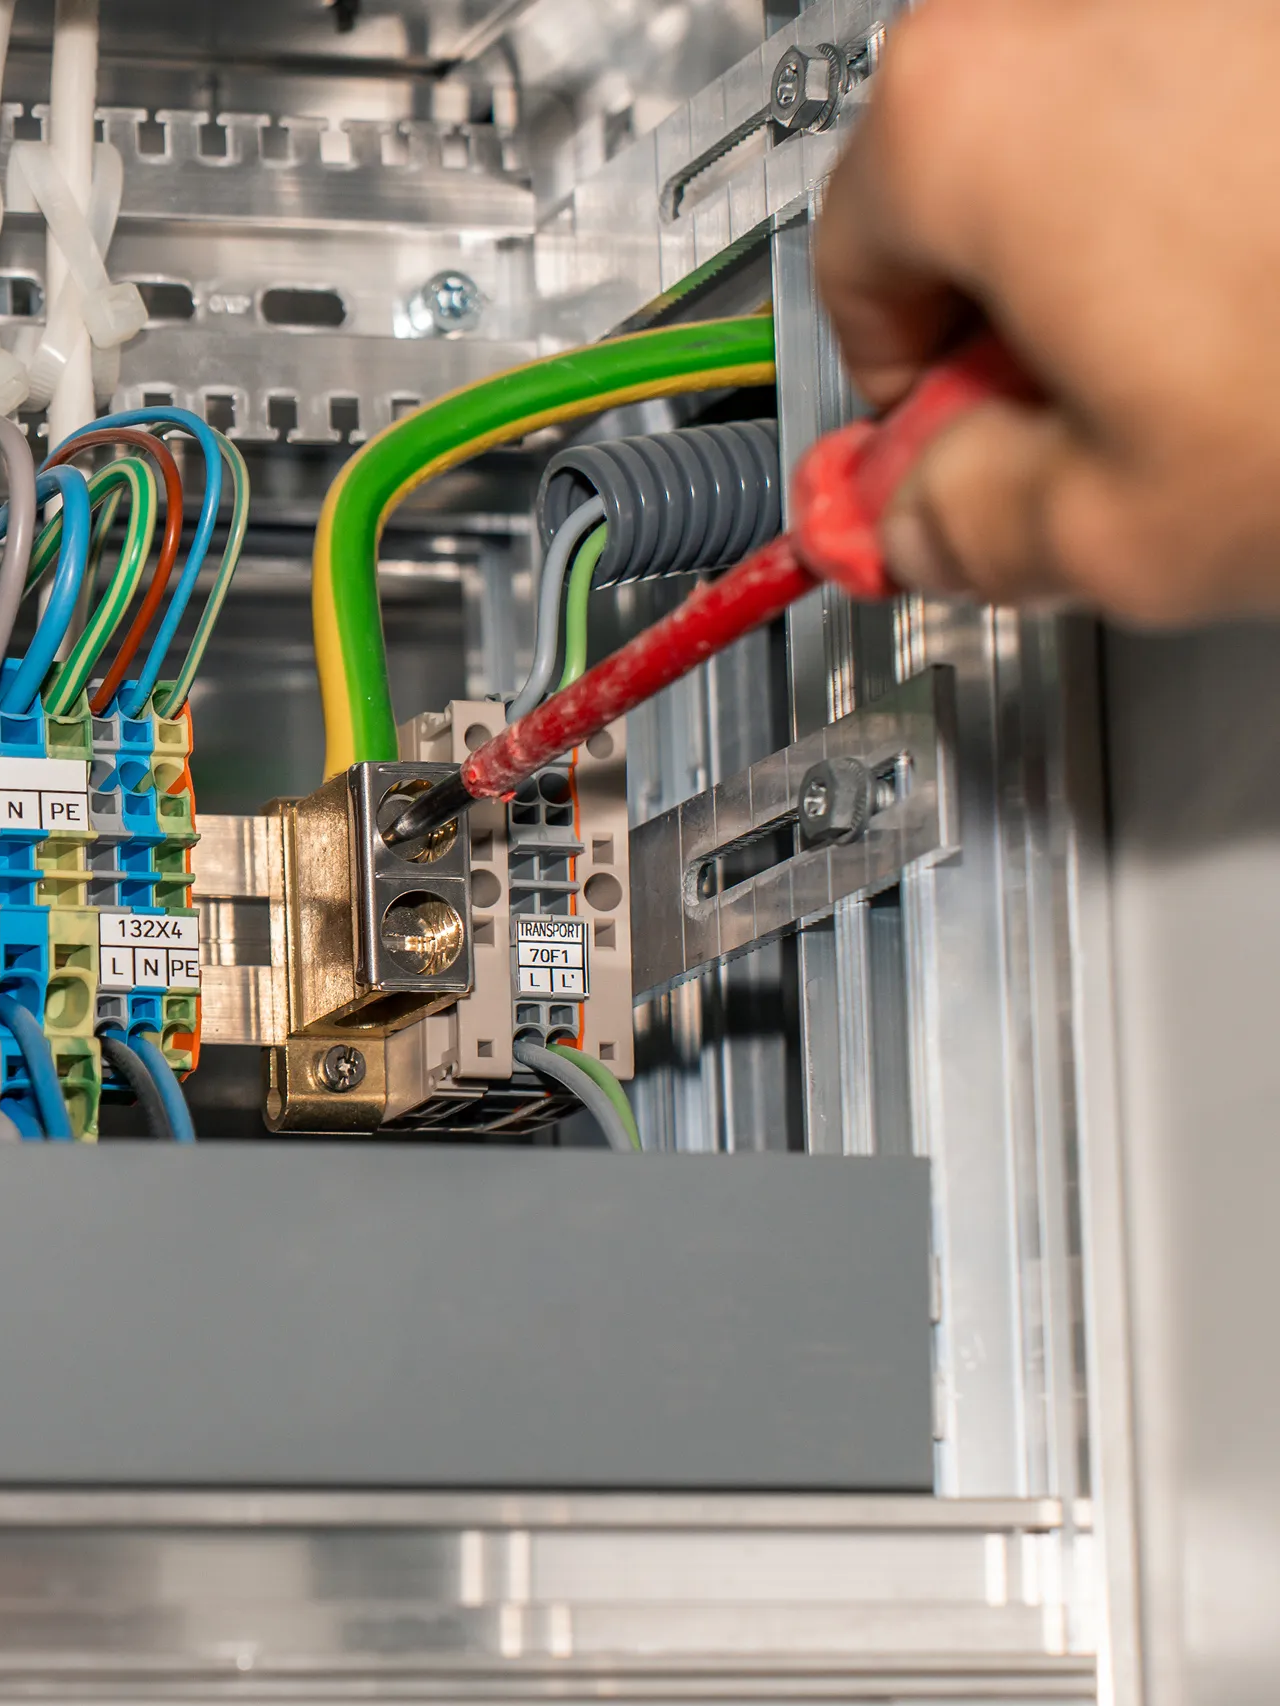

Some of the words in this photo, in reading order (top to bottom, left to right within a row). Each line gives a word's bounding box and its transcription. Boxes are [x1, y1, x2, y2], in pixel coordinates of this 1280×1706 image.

[7, 801, 24, 819] N
[50, 802, 81, 821] PE
[117, 919, 183, 939] 132X4
[519, 922, 581, 939] TRANSPORT
[529, 948, 569, 964] 70F1
[112, 957, 124, 976] L
[144, 958, 159, 977] N
[171, 959, 199, 979] PE
[529, 972, 541, 987] L
